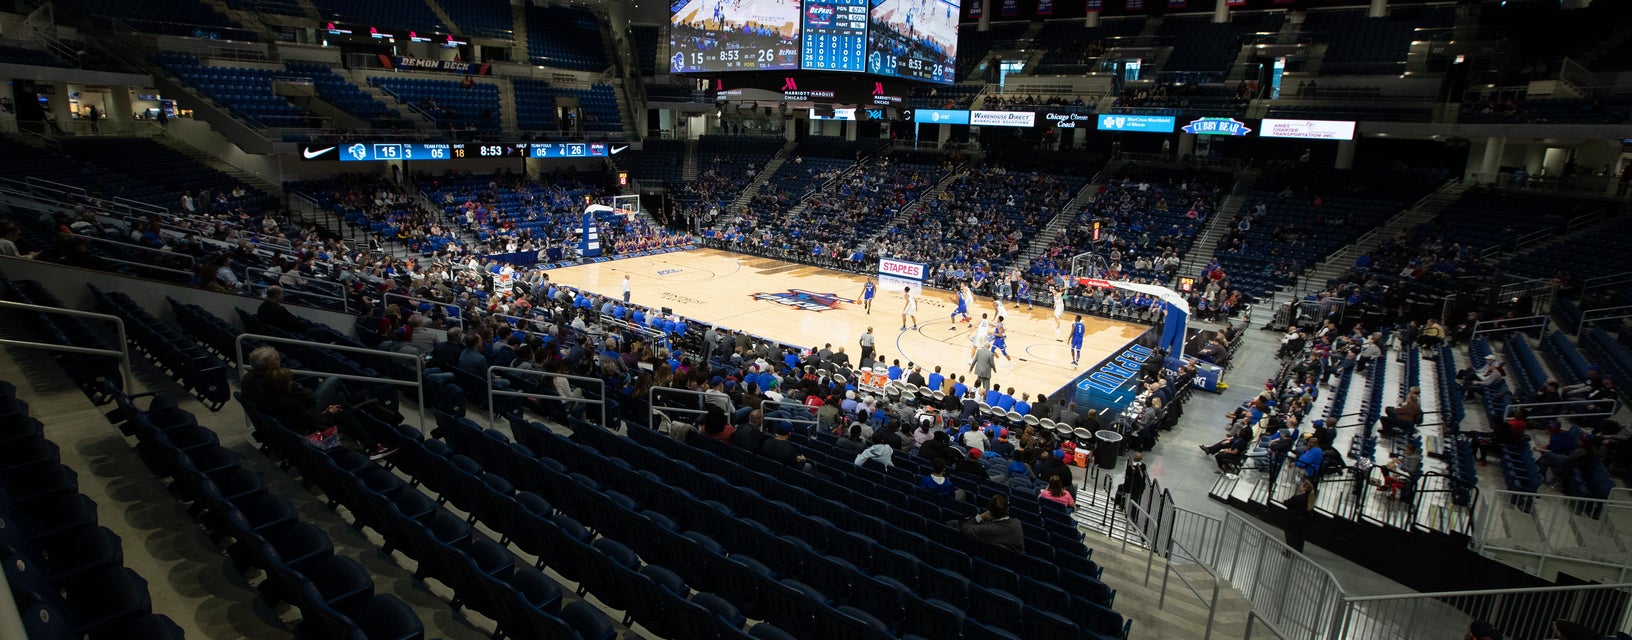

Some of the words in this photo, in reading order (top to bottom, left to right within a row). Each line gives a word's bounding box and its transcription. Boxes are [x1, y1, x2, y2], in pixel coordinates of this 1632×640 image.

[691, 53, 703, 64] 15
[720, 50, 739, 60] 8:53
[758, 49, 774, 62] 26
[401, 57, 439, 68] DEMON
[443, 61, 470, 70] DECK
[886, 55, 897, 68] 15
[908, 58, 922, 70] 8:53
[932, 63, 943, 76] 26
[1046, 112, 1069, 121] Chicago
[1193, 121, 1217, 131] CUBBY
[1218, 122, 1240, 133] BEAR
[381, 146, 396, 157] 15
[405, 149, 412, 158] 3
[431, 149, 443, 158] 05
[454, 149, 465, 157] 18
[480, 145, 502, 156] 8:53
[520, 148, 524, 156] 1
[536, 148, 547, 156] 05
[559, 148, 565, 156] 4
[571, 145, 582, 155] 26
[883, 262, 920, 276] STAPLES
[1076, 343, 1153, 395] DEPAUL
